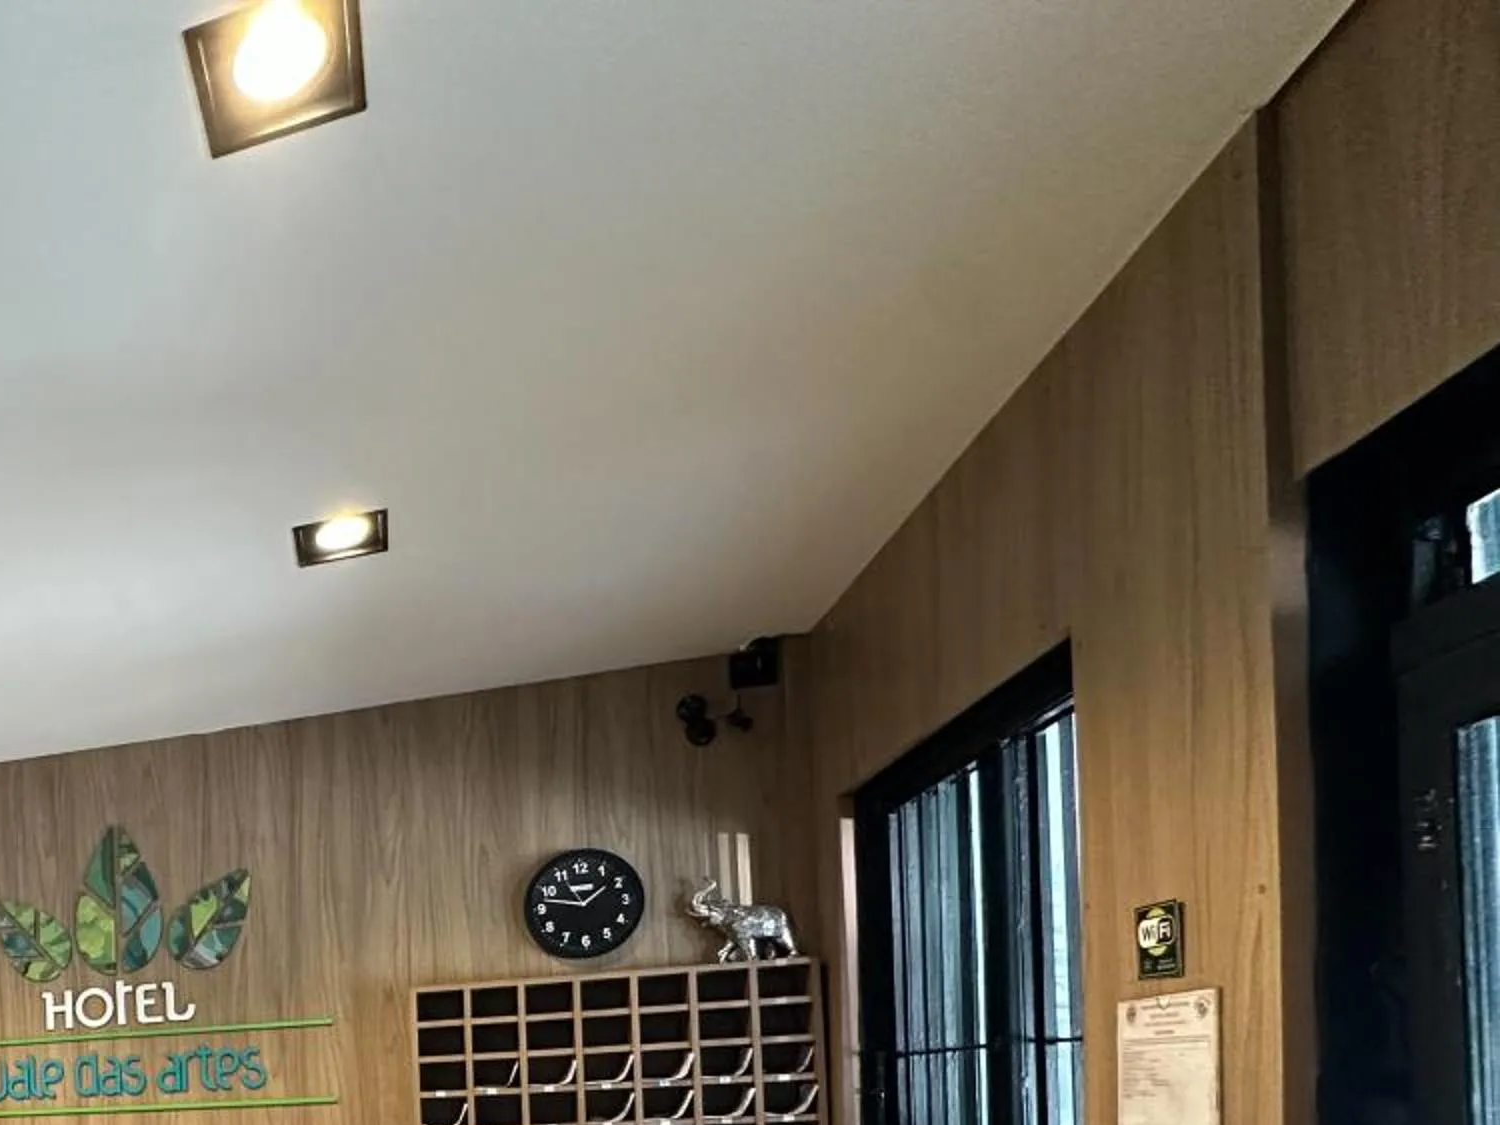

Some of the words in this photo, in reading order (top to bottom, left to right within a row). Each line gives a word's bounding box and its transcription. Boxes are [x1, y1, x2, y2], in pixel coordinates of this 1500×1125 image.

[572, 862, 589, 875] 12
[597, 865, 605, 877] 1
[554, 869, 568, 882] 11
[614, 877, 623, 889] 2
[542, 885, 557, 897] 10
[621, 893, 630, 905] 3
[537, 903, 547, 915] 9
[616, 913, 625, 925] 4
[545, 921, 555, 933] 8
[603, 927, 612, 939] 5
[562, 931, 571, 943] 7
[581, 935, 591, 947] 6
[41, 979, 197, 1031] HOTEL
[73, 1052, 148, 1098] das
[158, 1045, 267, 1093] artes
